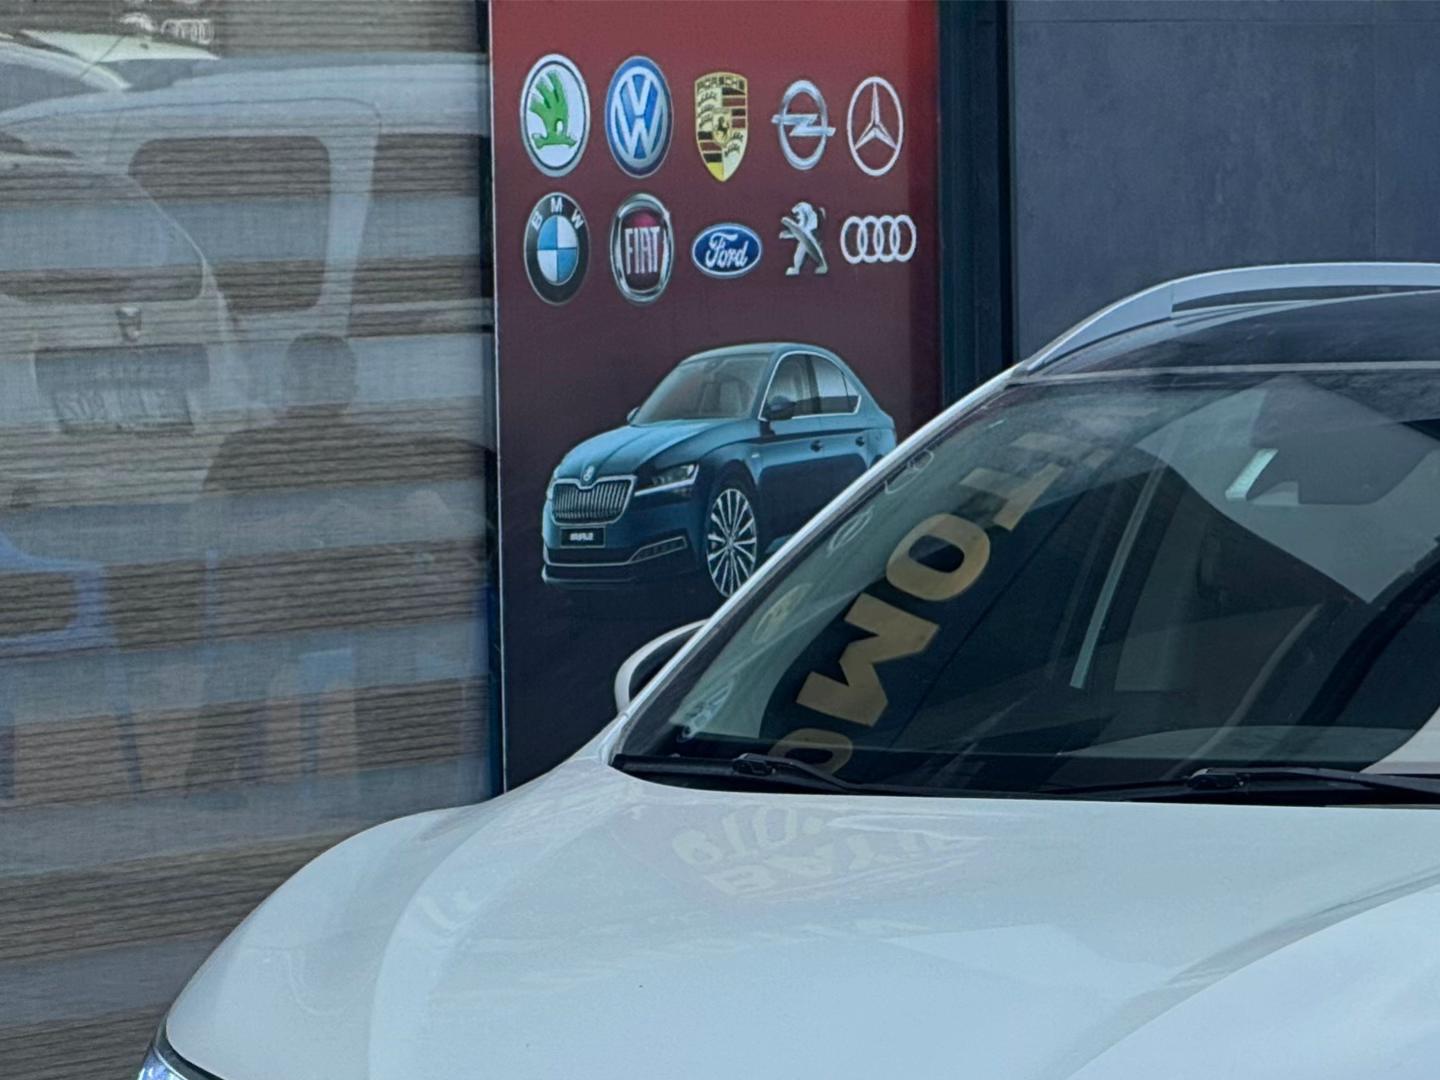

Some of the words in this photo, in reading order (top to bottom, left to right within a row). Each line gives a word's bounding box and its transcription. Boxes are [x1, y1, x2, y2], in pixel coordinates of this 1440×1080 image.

[531, 196, 585, 231] BMW
[624, 226, 661, 274] FIAT
[704, 232, 750, 268] Ford
